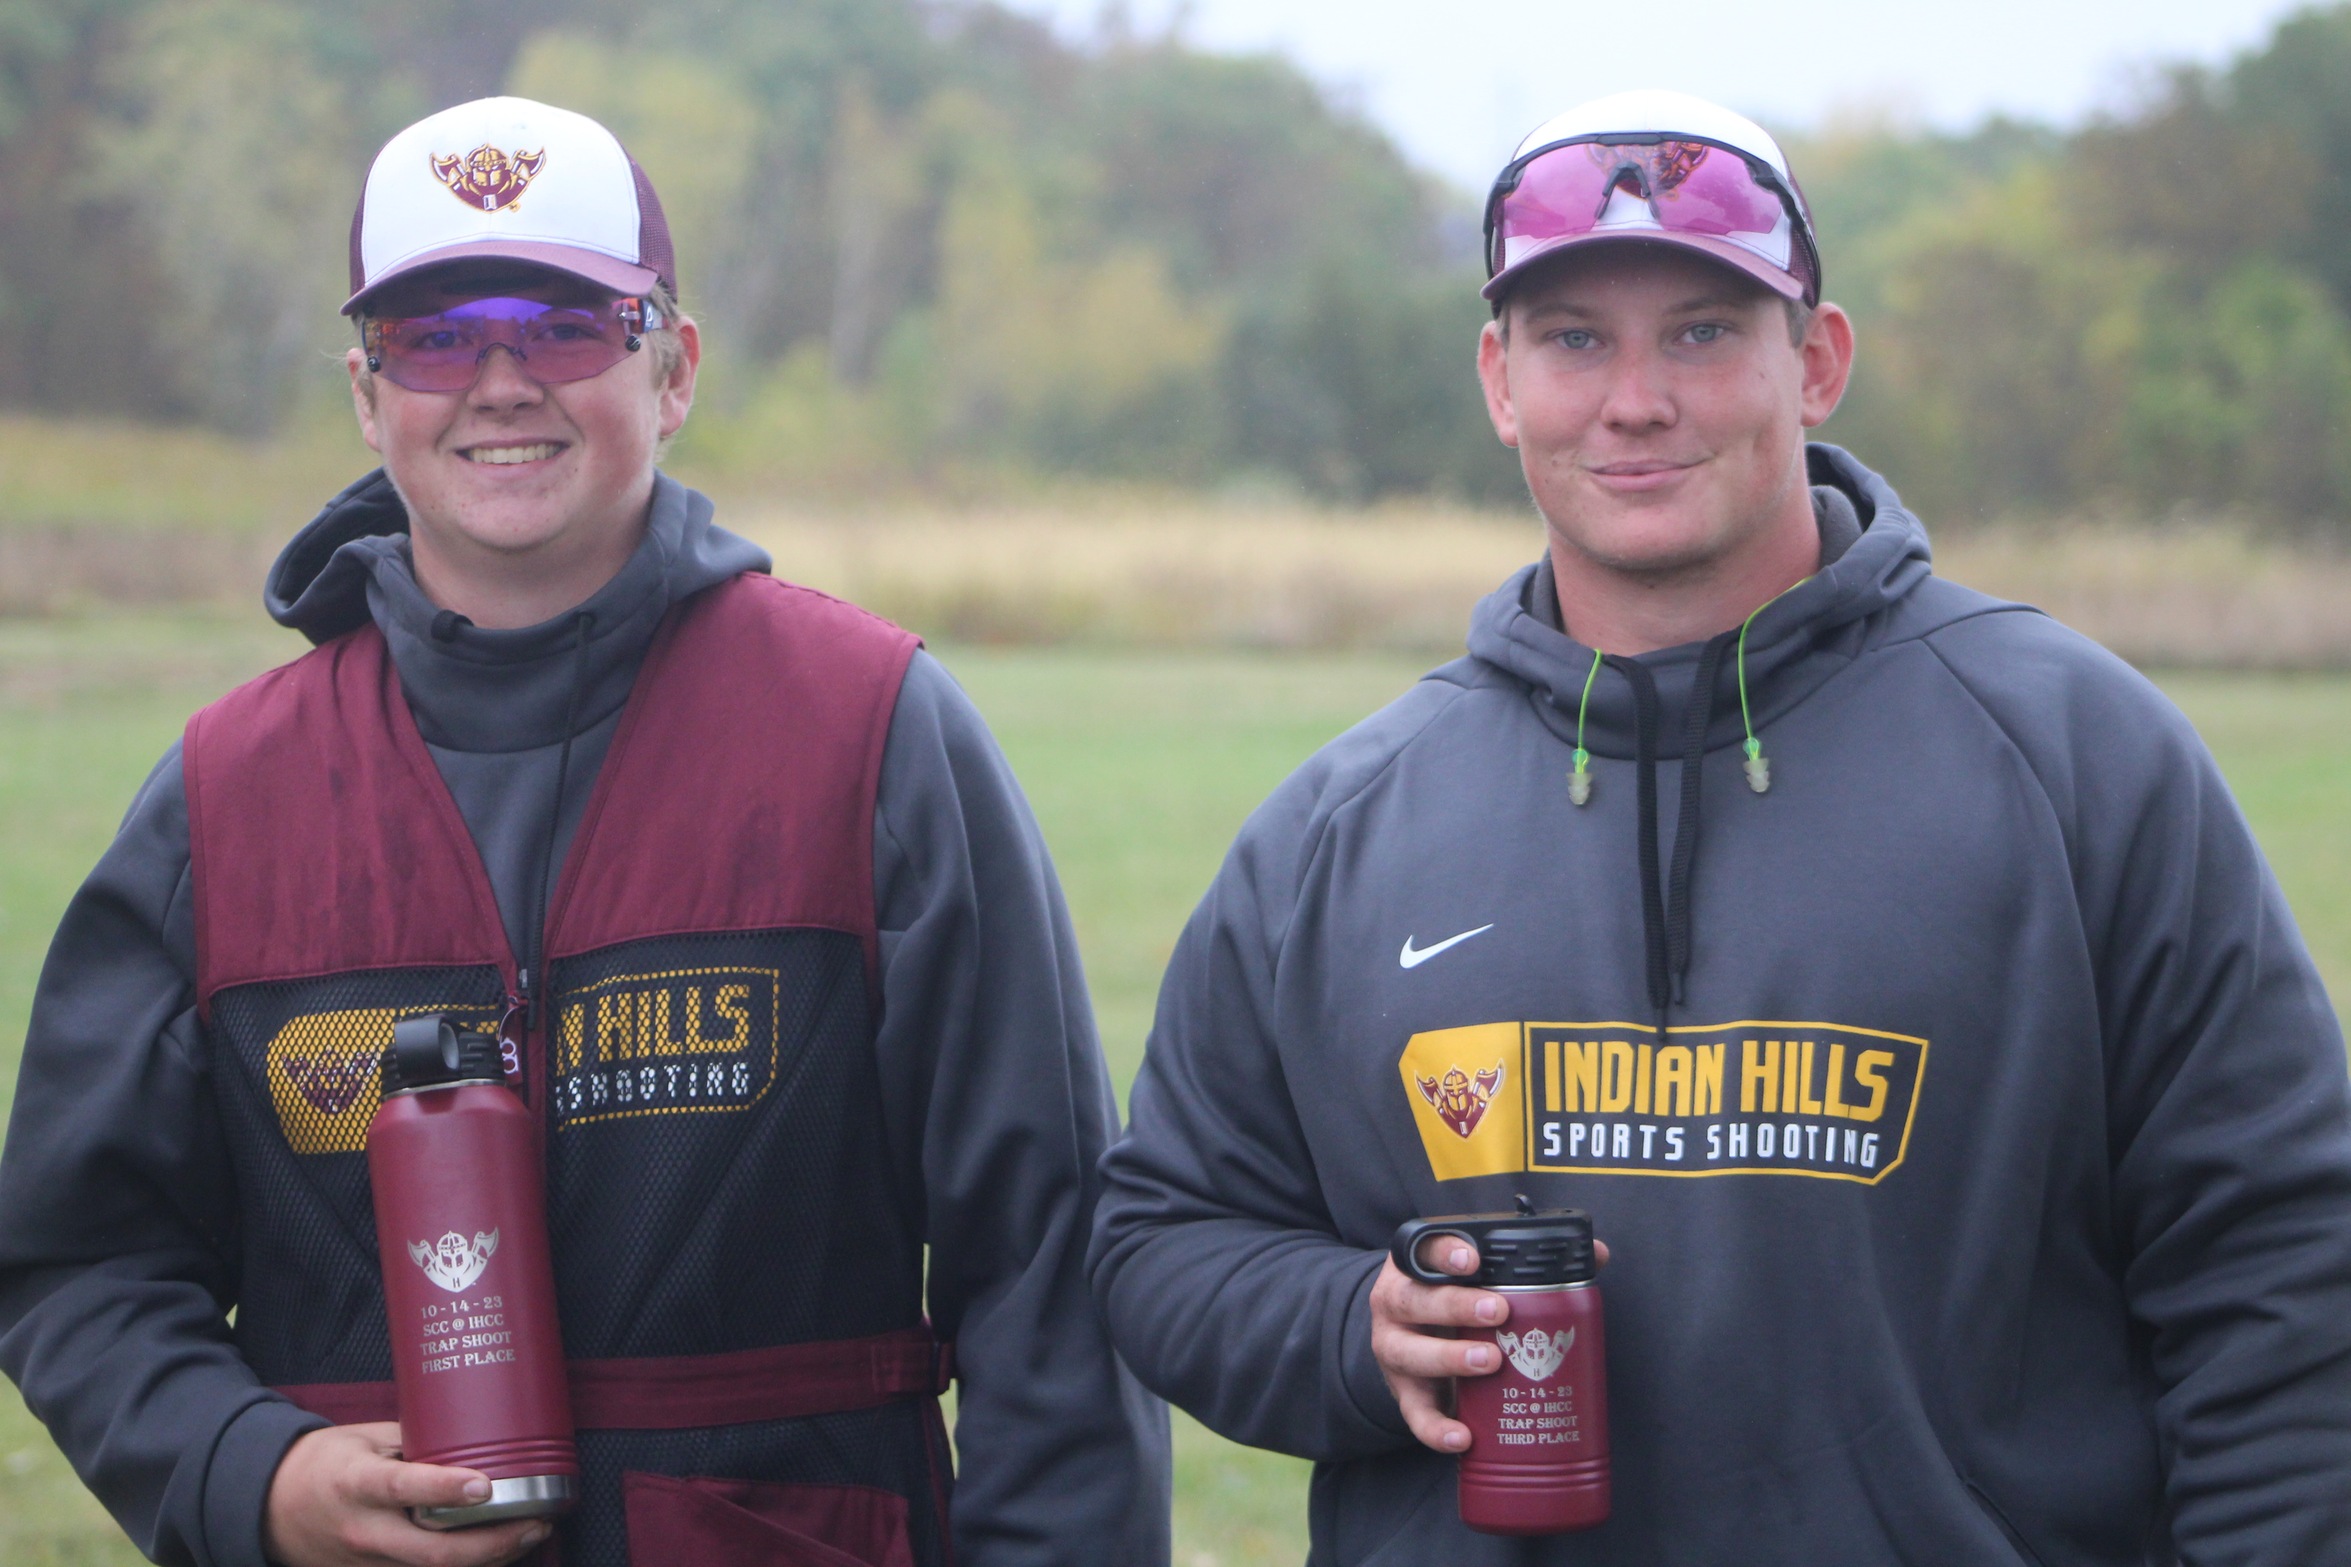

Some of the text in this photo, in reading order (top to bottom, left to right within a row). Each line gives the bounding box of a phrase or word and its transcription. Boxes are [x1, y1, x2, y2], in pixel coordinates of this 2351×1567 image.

[598, 984, 750, 1063] HILLS
[1544, 1039, 1895, 1123] INDIAN HILLS
[1543, 1122, 1879, 1168] SPORTS SHOOTING
[423, 1314, 504, 1337] SCC @ IHCC
[420, 1331, 512, 1356] TRAP SHOOT
[422, 1349, 516, 1374] FIRST PLACE
[1502, 1401, 1573, 1414] SCC @ IHCC
[1498, 1416, 1578, 1429] TRAP SHOOT
[1497, 1431, 1580, 1445] THIRD PLACE
